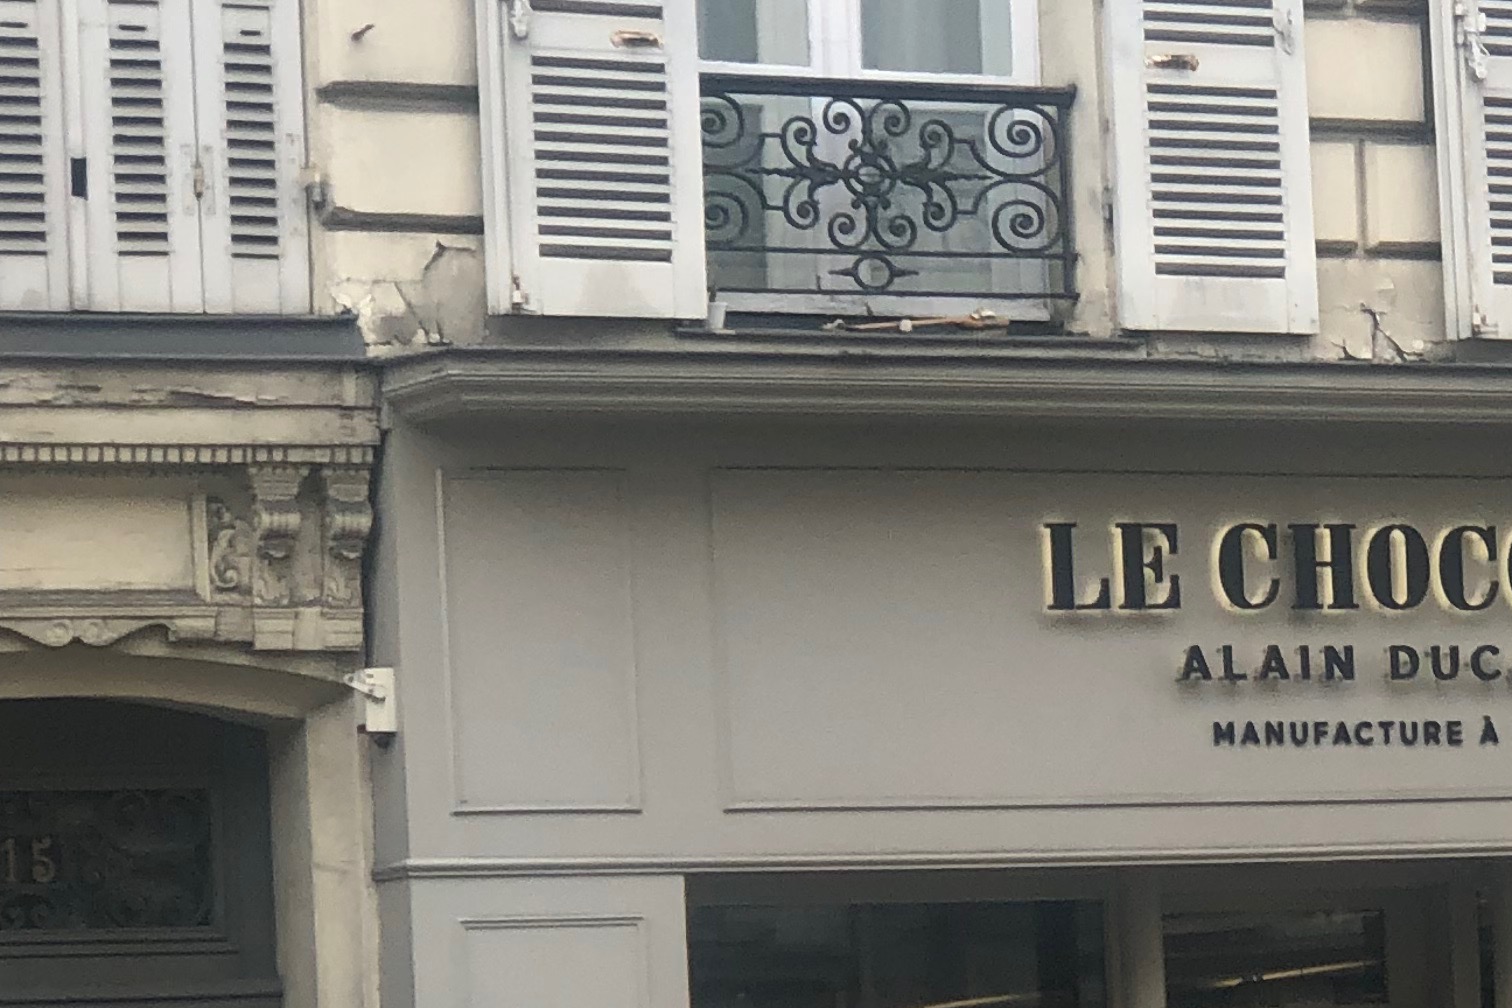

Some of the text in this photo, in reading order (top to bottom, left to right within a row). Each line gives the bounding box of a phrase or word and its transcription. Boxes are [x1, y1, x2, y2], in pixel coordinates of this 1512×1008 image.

[1042, 521, 1182, 611] LE
[1180, 643, 1356, 682] ALAIN
[1212, 720, 1464, 747] MANUFACTURE
[1479, 715, 1499, 746] À
